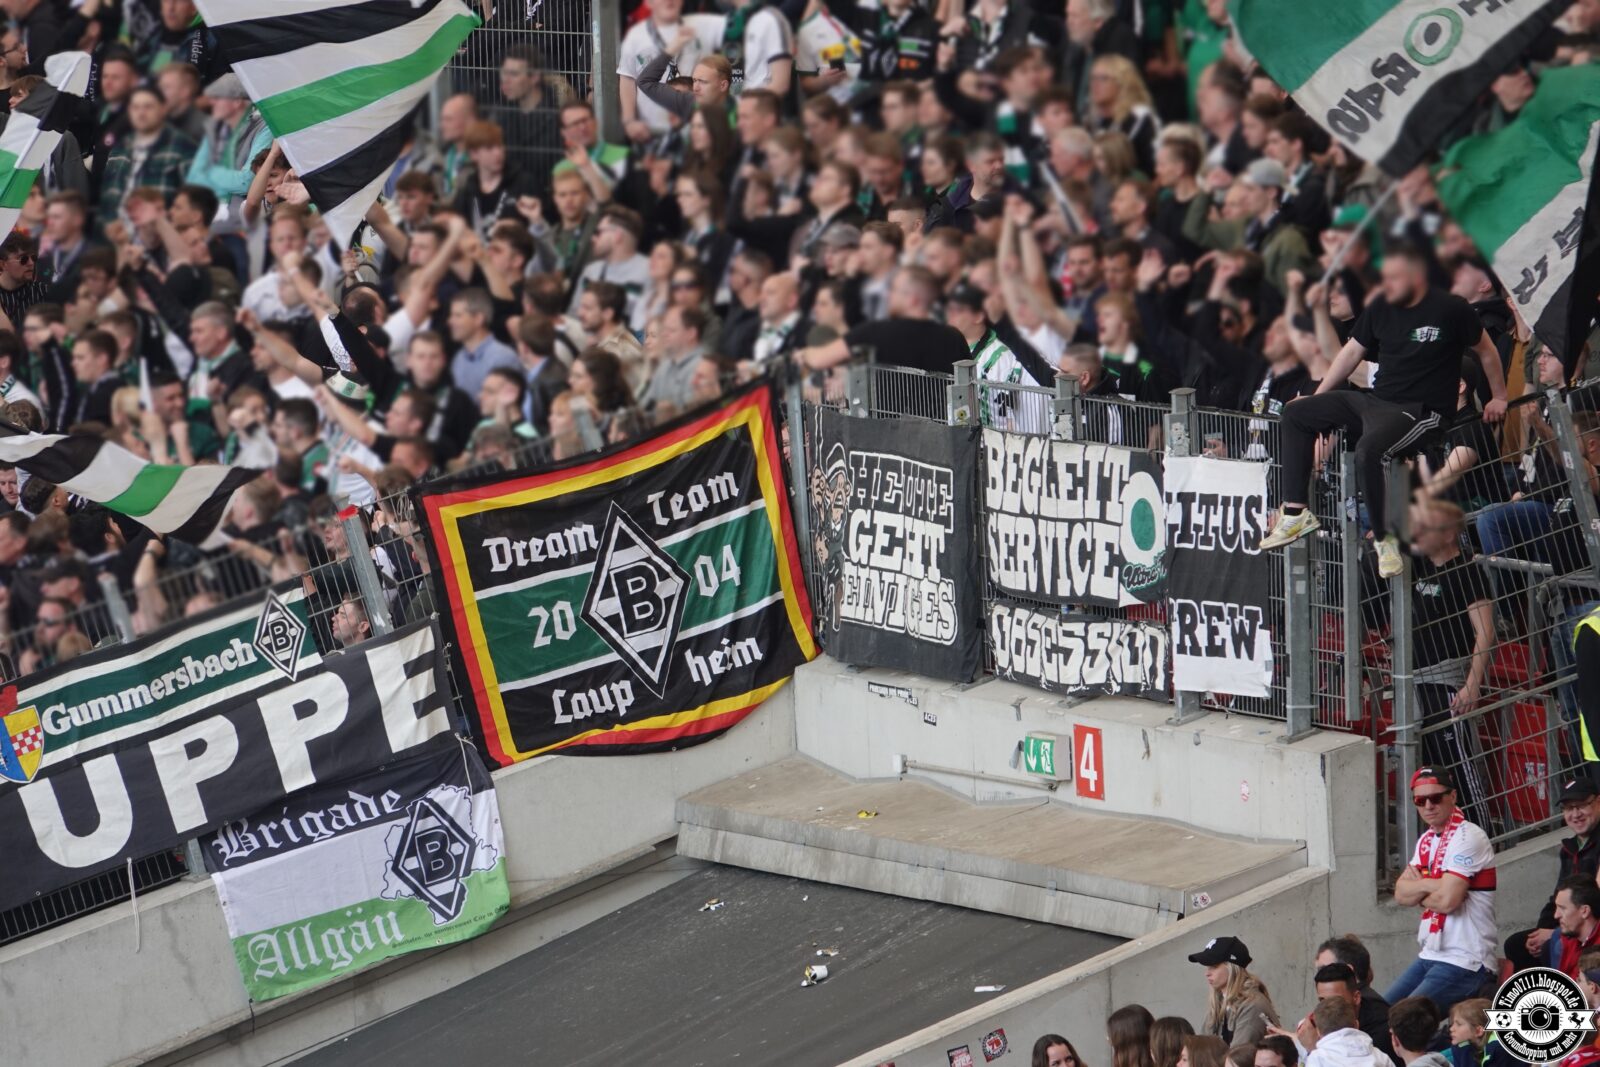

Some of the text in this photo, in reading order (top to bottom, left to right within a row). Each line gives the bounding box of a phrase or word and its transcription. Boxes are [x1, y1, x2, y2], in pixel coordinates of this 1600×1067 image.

[848, 451, 954, 534] HEUTE
[983, 427, 1131, 524] BEGLEIT
[482, 471, 740, 573] Dream Team
[849, 508, 945, 583] GEHT
[987, 511, 1121, 600] SERVICE
[1165, 491, 1264, 555] ITUS
[527, 544, 742, 648] 20 04
[610, 560, 668, 639] B
[840, 560, 958, 646] EINIGES
[1168, 599, 1262, 661] REW
[41, 637, 258, 736] Gummersbach
[685, 637, 763, 687] heim
[551, 679, 635, 725] Laup
[18, 625, 452, 869] UPPE
[1080, 733, 1098, 792] 4
[211, 789, 406, 866] Brigade
[247, 907, 405, 982] Allgäu
